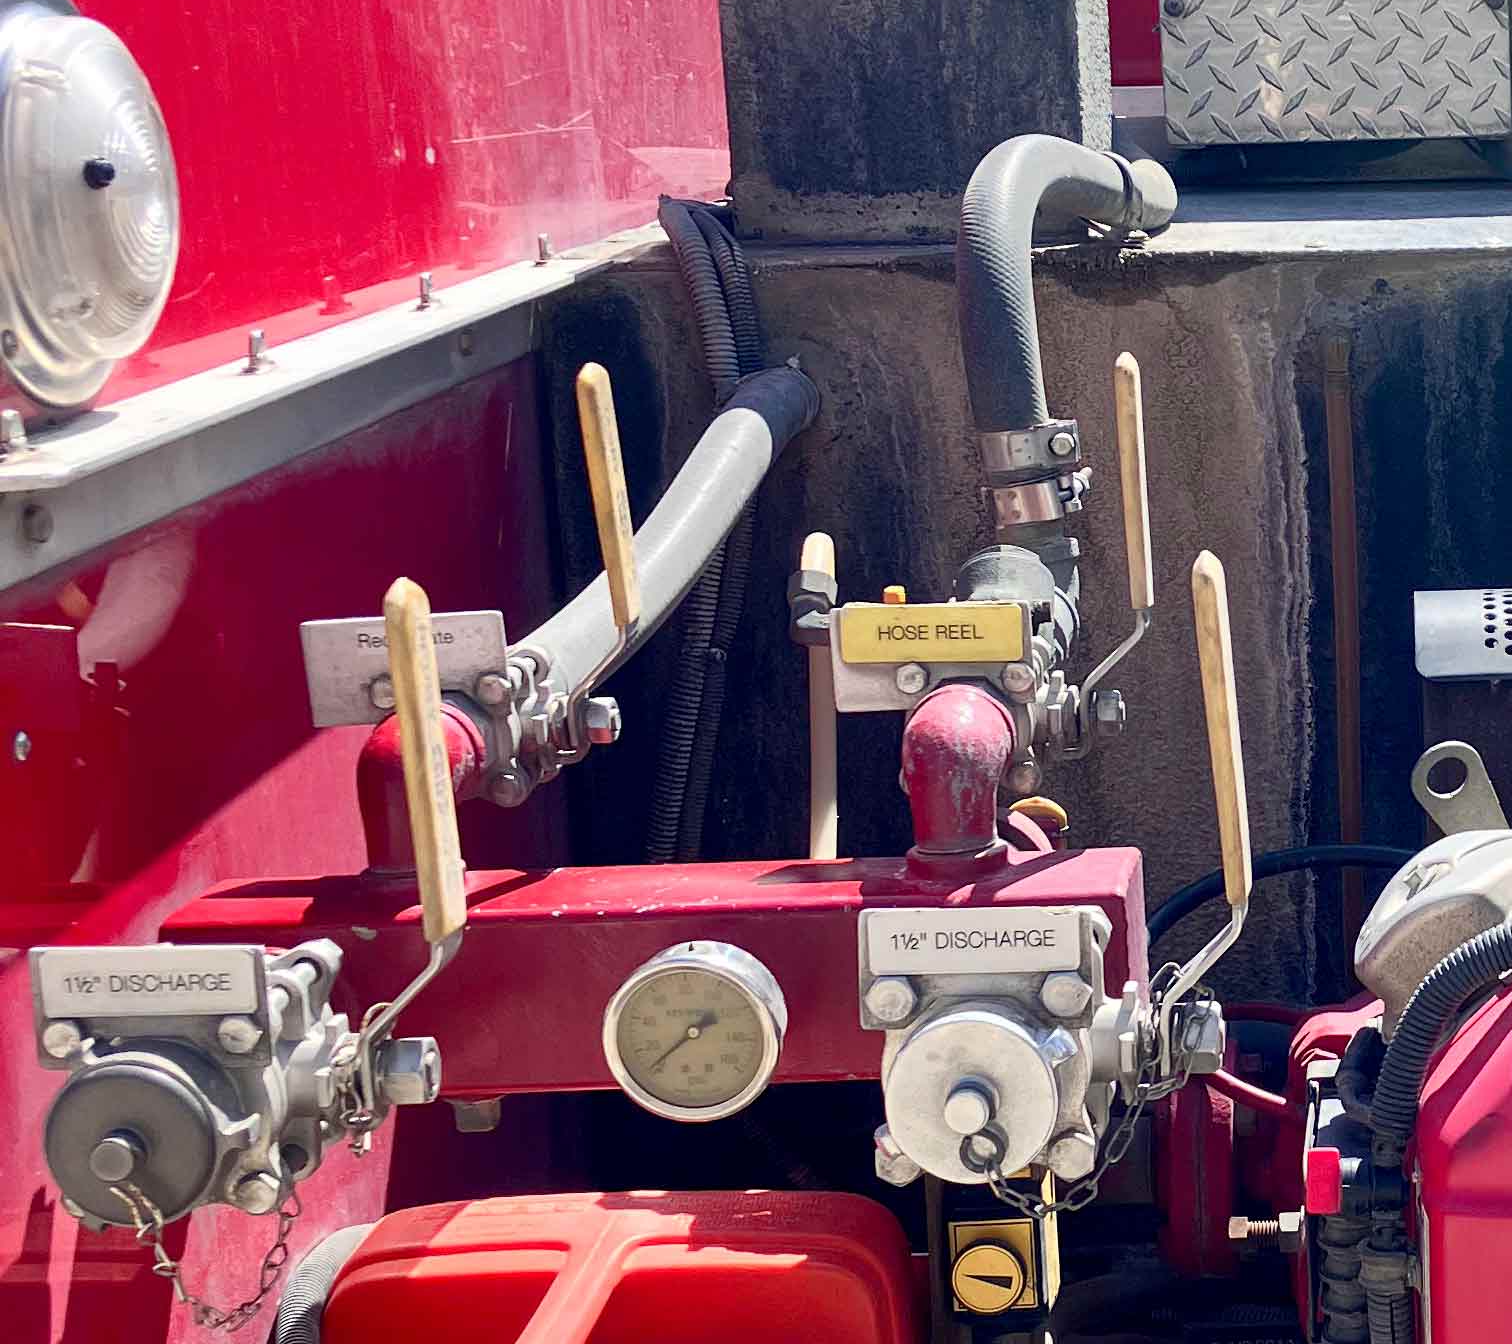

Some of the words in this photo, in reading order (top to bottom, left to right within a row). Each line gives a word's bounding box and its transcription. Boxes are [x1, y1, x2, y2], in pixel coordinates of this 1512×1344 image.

[878, 624, 929, 641] HOSE
[935, 623, 985, 640] REEL
[935, 929, 1056, 950] DISCHARGE
[109, 973, 232, 993] DISCHARGE
